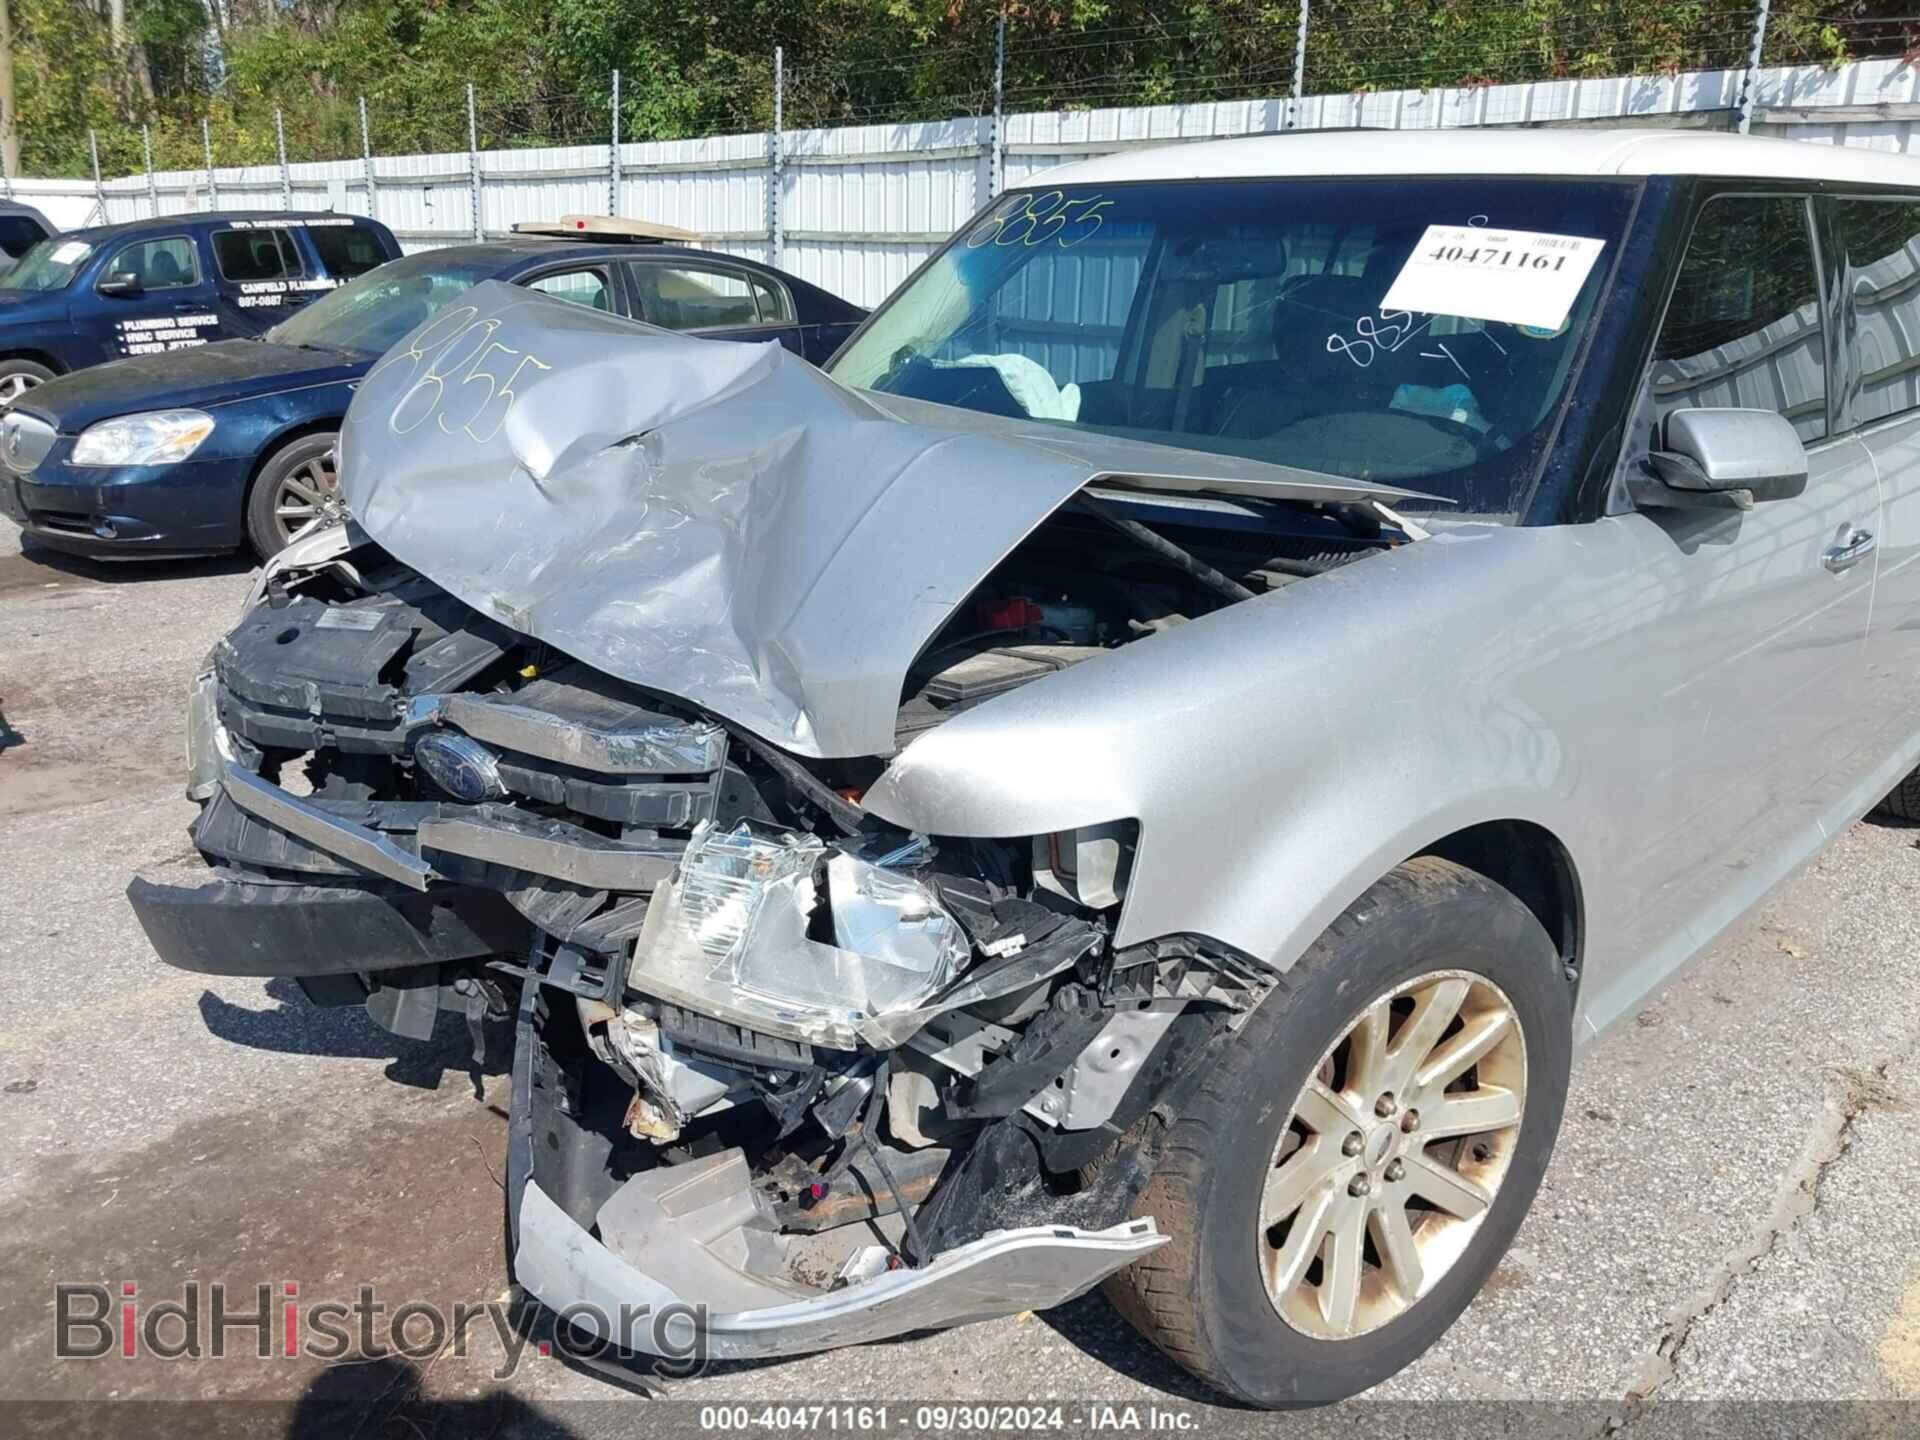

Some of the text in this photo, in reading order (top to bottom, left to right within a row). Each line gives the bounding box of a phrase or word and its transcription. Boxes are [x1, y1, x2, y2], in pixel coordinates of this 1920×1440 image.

[967, 190, 1115, 248] 8855
[1429, 245, 1567, 272] 40471161
[241, 281, 287, 294] CANFIELD
[123, 314, 219, 331] PLUMBING SERVICE
[126, 328, 197, 343] HVAC SERVICE
[129, 343, 165, 355] SEWER
[350, 306, 552, 443] 8855
